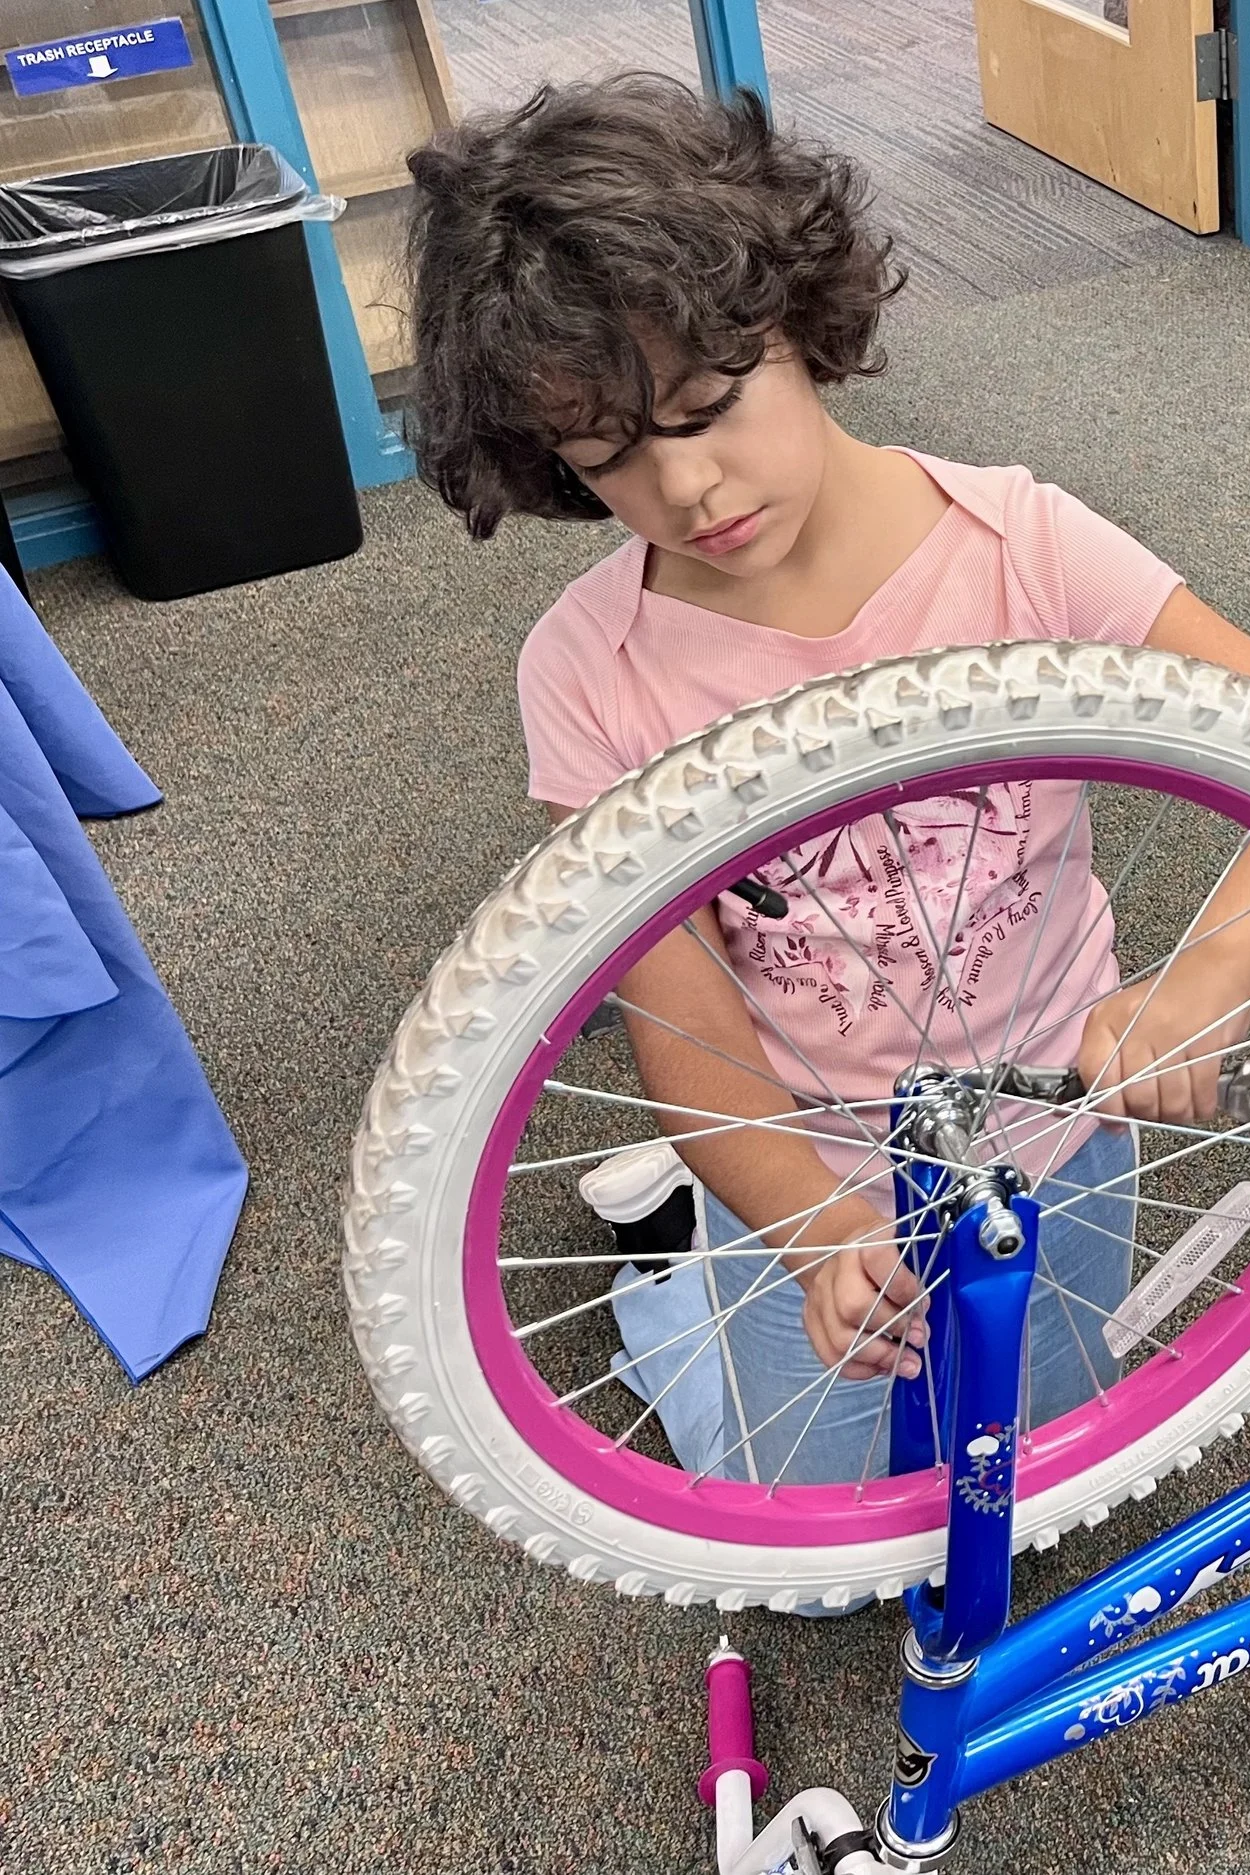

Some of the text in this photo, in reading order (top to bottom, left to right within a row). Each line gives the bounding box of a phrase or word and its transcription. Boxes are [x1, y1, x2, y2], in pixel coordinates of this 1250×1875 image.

[17, 30, 155, 67] TRASH RECEPTACLE
[887, 897, 914, 937] Loved
[901, 934, 919, 949] &
